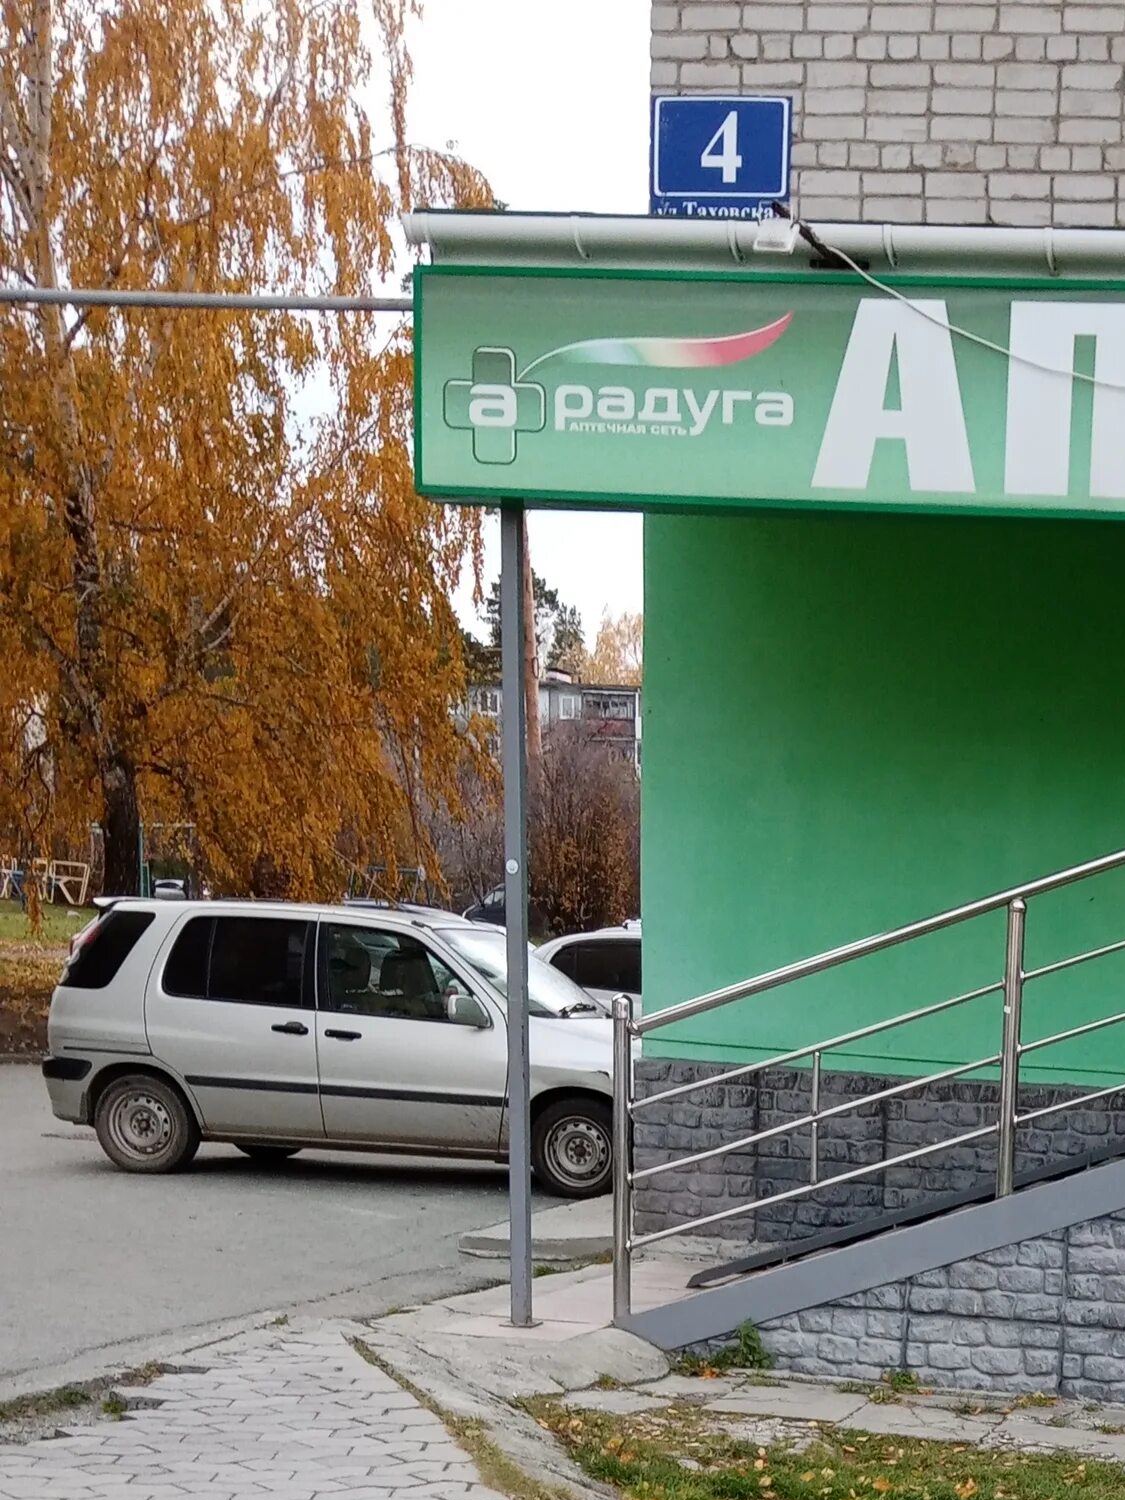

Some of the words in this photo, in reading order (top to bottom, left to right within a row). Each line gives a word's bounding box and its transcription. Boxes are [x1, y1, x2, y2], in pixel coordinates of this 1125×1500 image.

[700, 110, 743, 184] 4
[554, 384, 795, 437] радуга
[568, 421, 646, 435] АПТЕЧНАЯ
[650, 424, 688, 437] СЕТЬ
